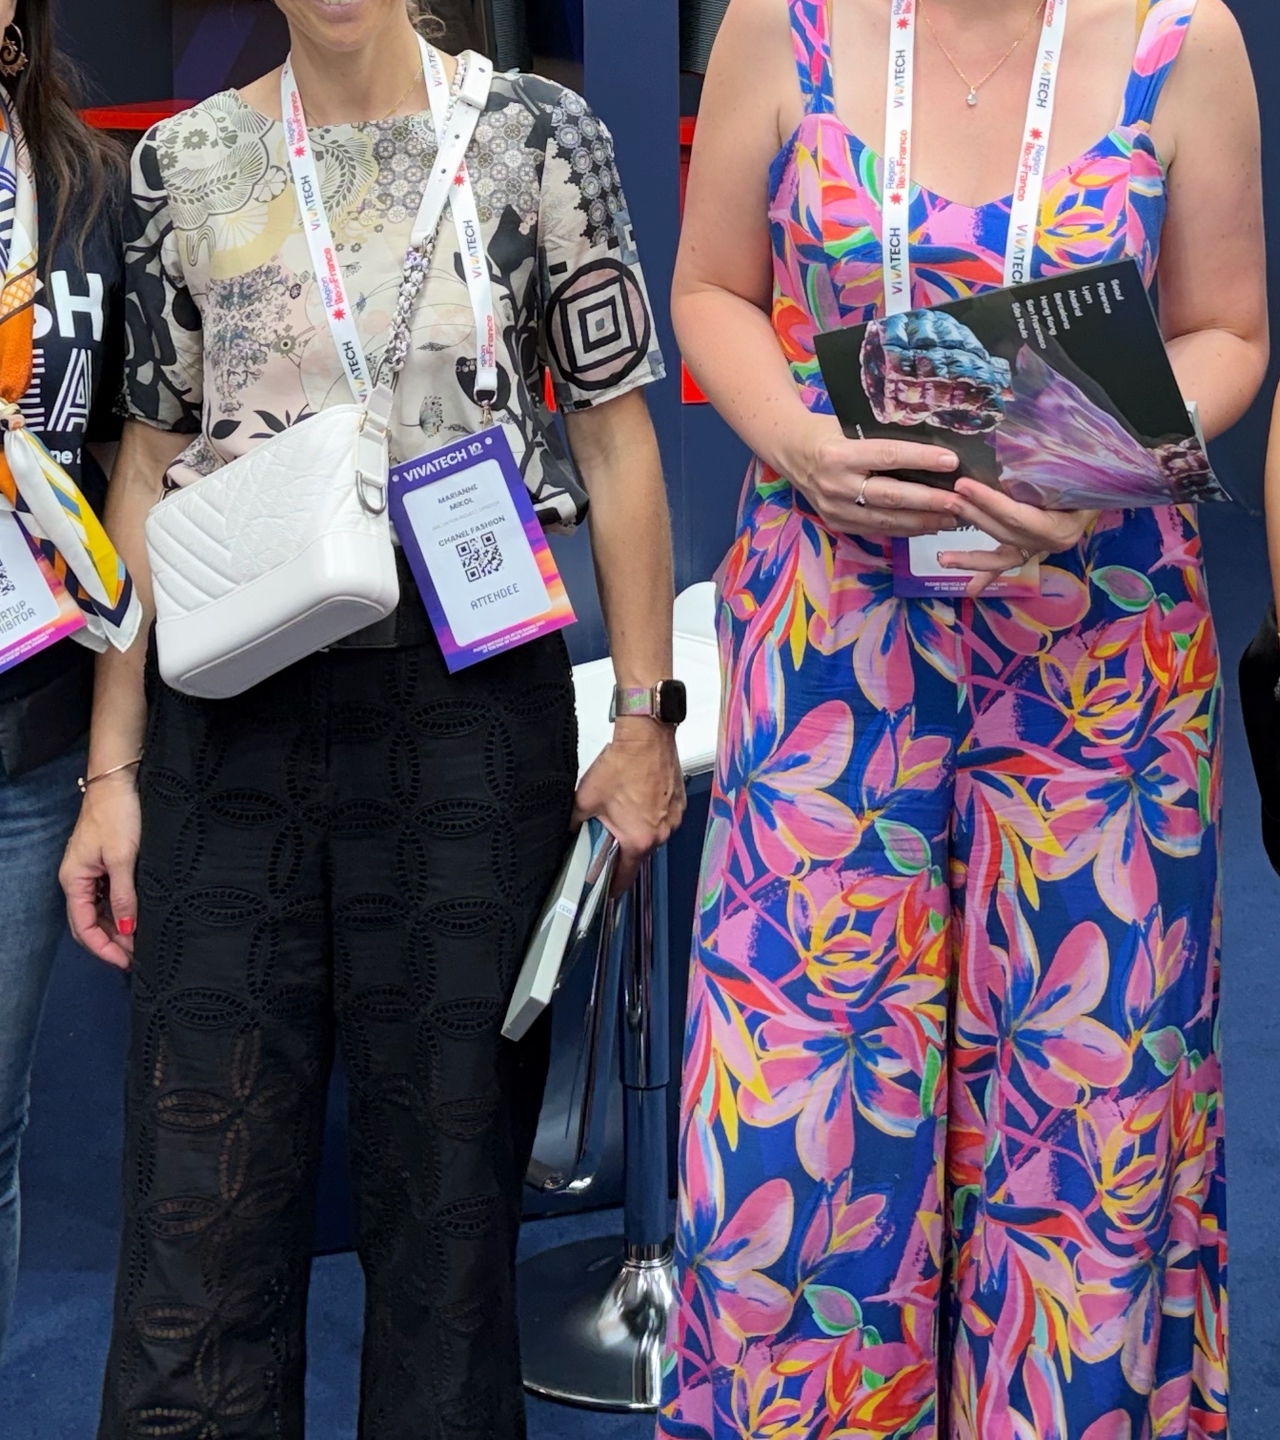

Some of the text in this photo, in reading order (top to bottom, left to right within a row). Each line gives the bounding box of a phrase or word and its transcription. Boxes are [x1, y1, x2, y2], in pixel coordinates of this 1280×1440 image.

[893, 49, 907, 109] VIVATECH
[1036, 49, 1054, 109] VIVATECH
[300, 174, 321, 232] VIVATECH
[462, 219, 483, 280] VIVATECH
[891, 227, 902, 296] VIVATECH
[1067, 290, 1083, 317] Madrid
[1082, 285, 1093, 304] Lyon
[1096, 282, 1112, 314] Florence
[1110, 279, 1125, 300] Seoul
[1016, 318, 1028, 339] Paulo
[1025, 299, 1047, 349] San Francisco
[1040, 295, 1057, 336] Hong Kong
[1053, 292, 1070, 330] Barcelona
[341, 340, 368, 403] VIVATECH
[403, 448, 468, 483] VIVATECH
[437, 483, 478, 505] MARIANNE
[449, 497, 474, 512] MIKOL
[438, 530, 470, 547] CHANEL
[470, 515, 506, 534] FASHION
[470, 582, 521, 610] ATTENDEE
